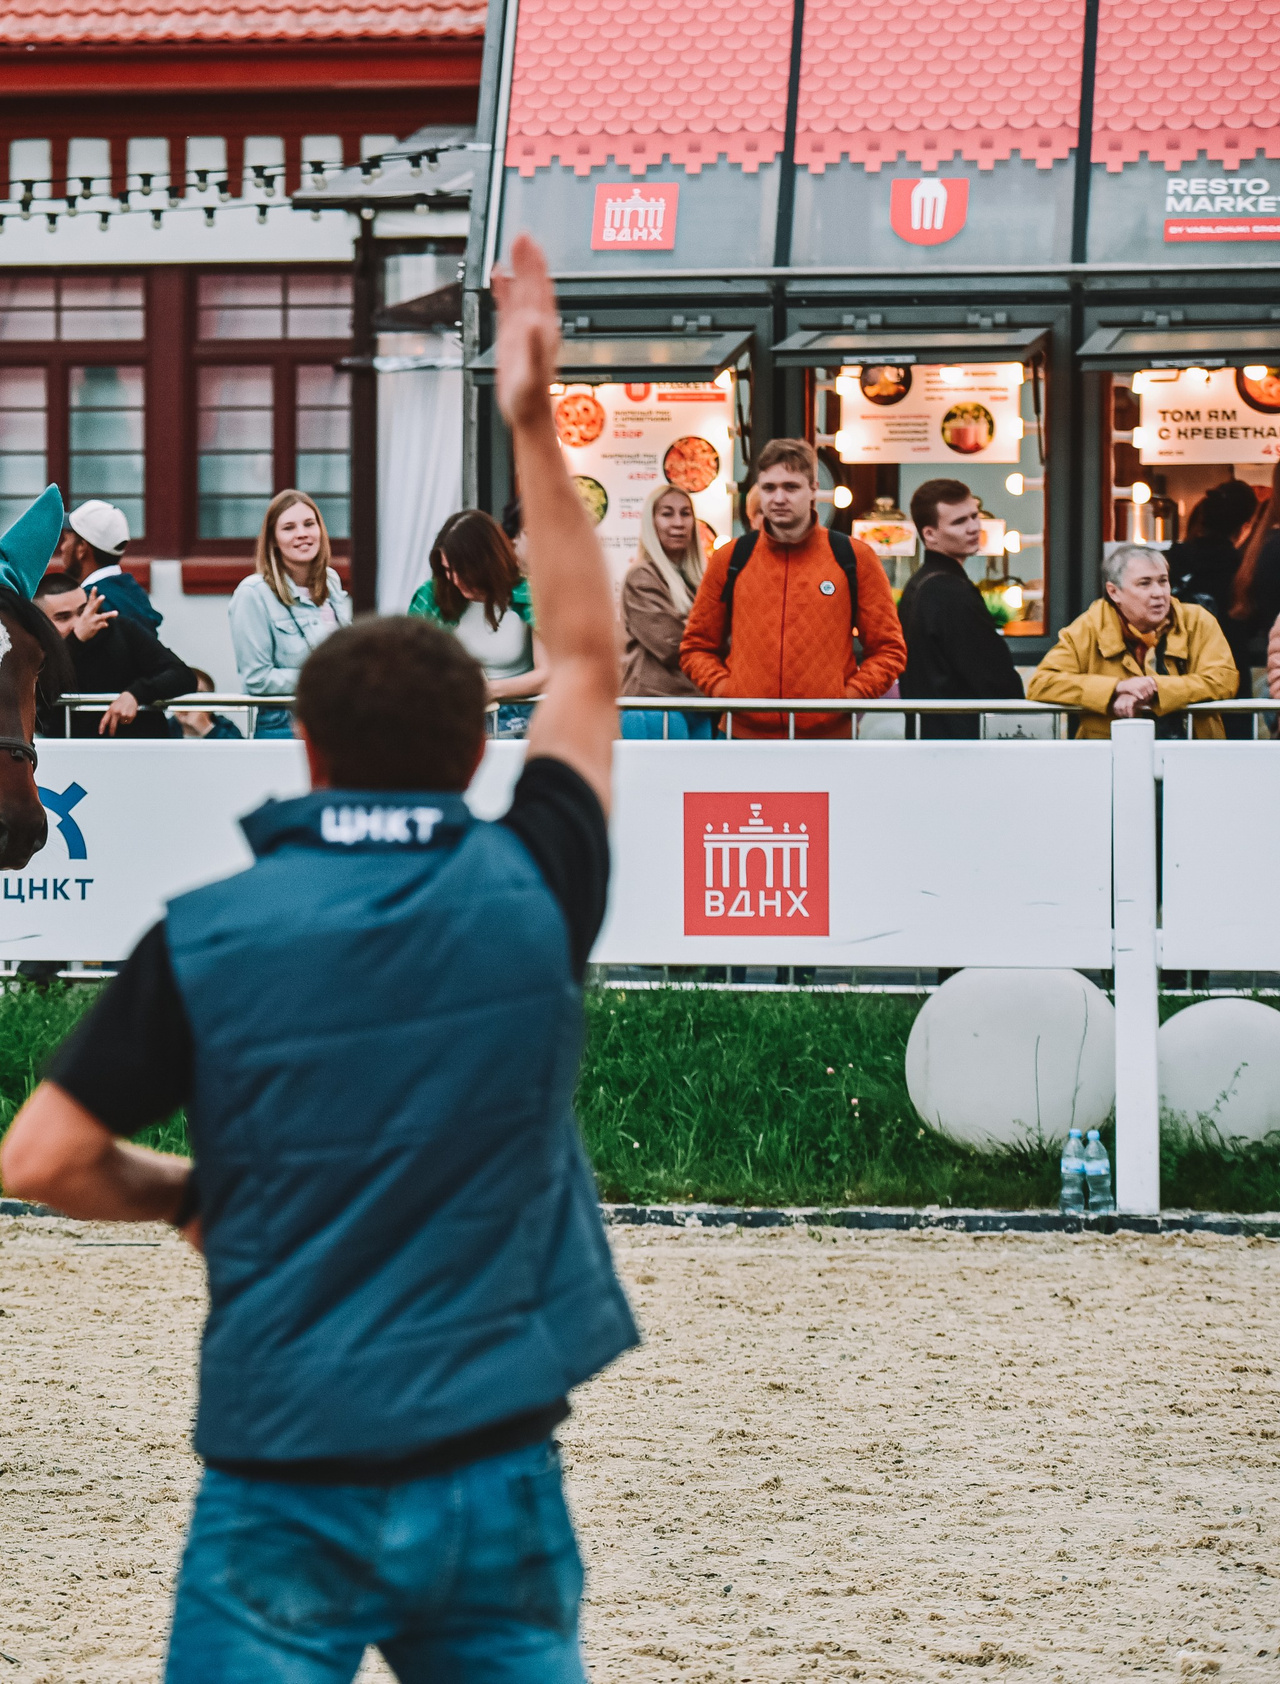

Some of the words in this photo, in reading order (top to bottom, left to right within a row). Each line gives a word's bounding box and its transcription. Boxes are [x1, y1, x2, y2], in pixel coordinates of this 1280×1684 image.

[1167, 177, 1271, 196] RESTO
[1165, 195, 1280, 213] MARKE
[602, 228, 663, 242] ВДНХ
[1158, 409, 1201, 422] ТОМ
[1207, 410, 1238, 421] ЯМ
[1158, 427, 1171, 440] С
[1177, 427, 1280, 440] КРЕВЕТКА
[3, 878, 95, 904] ЦНКТ
[704, 890, 810, 917] ВДНХ
